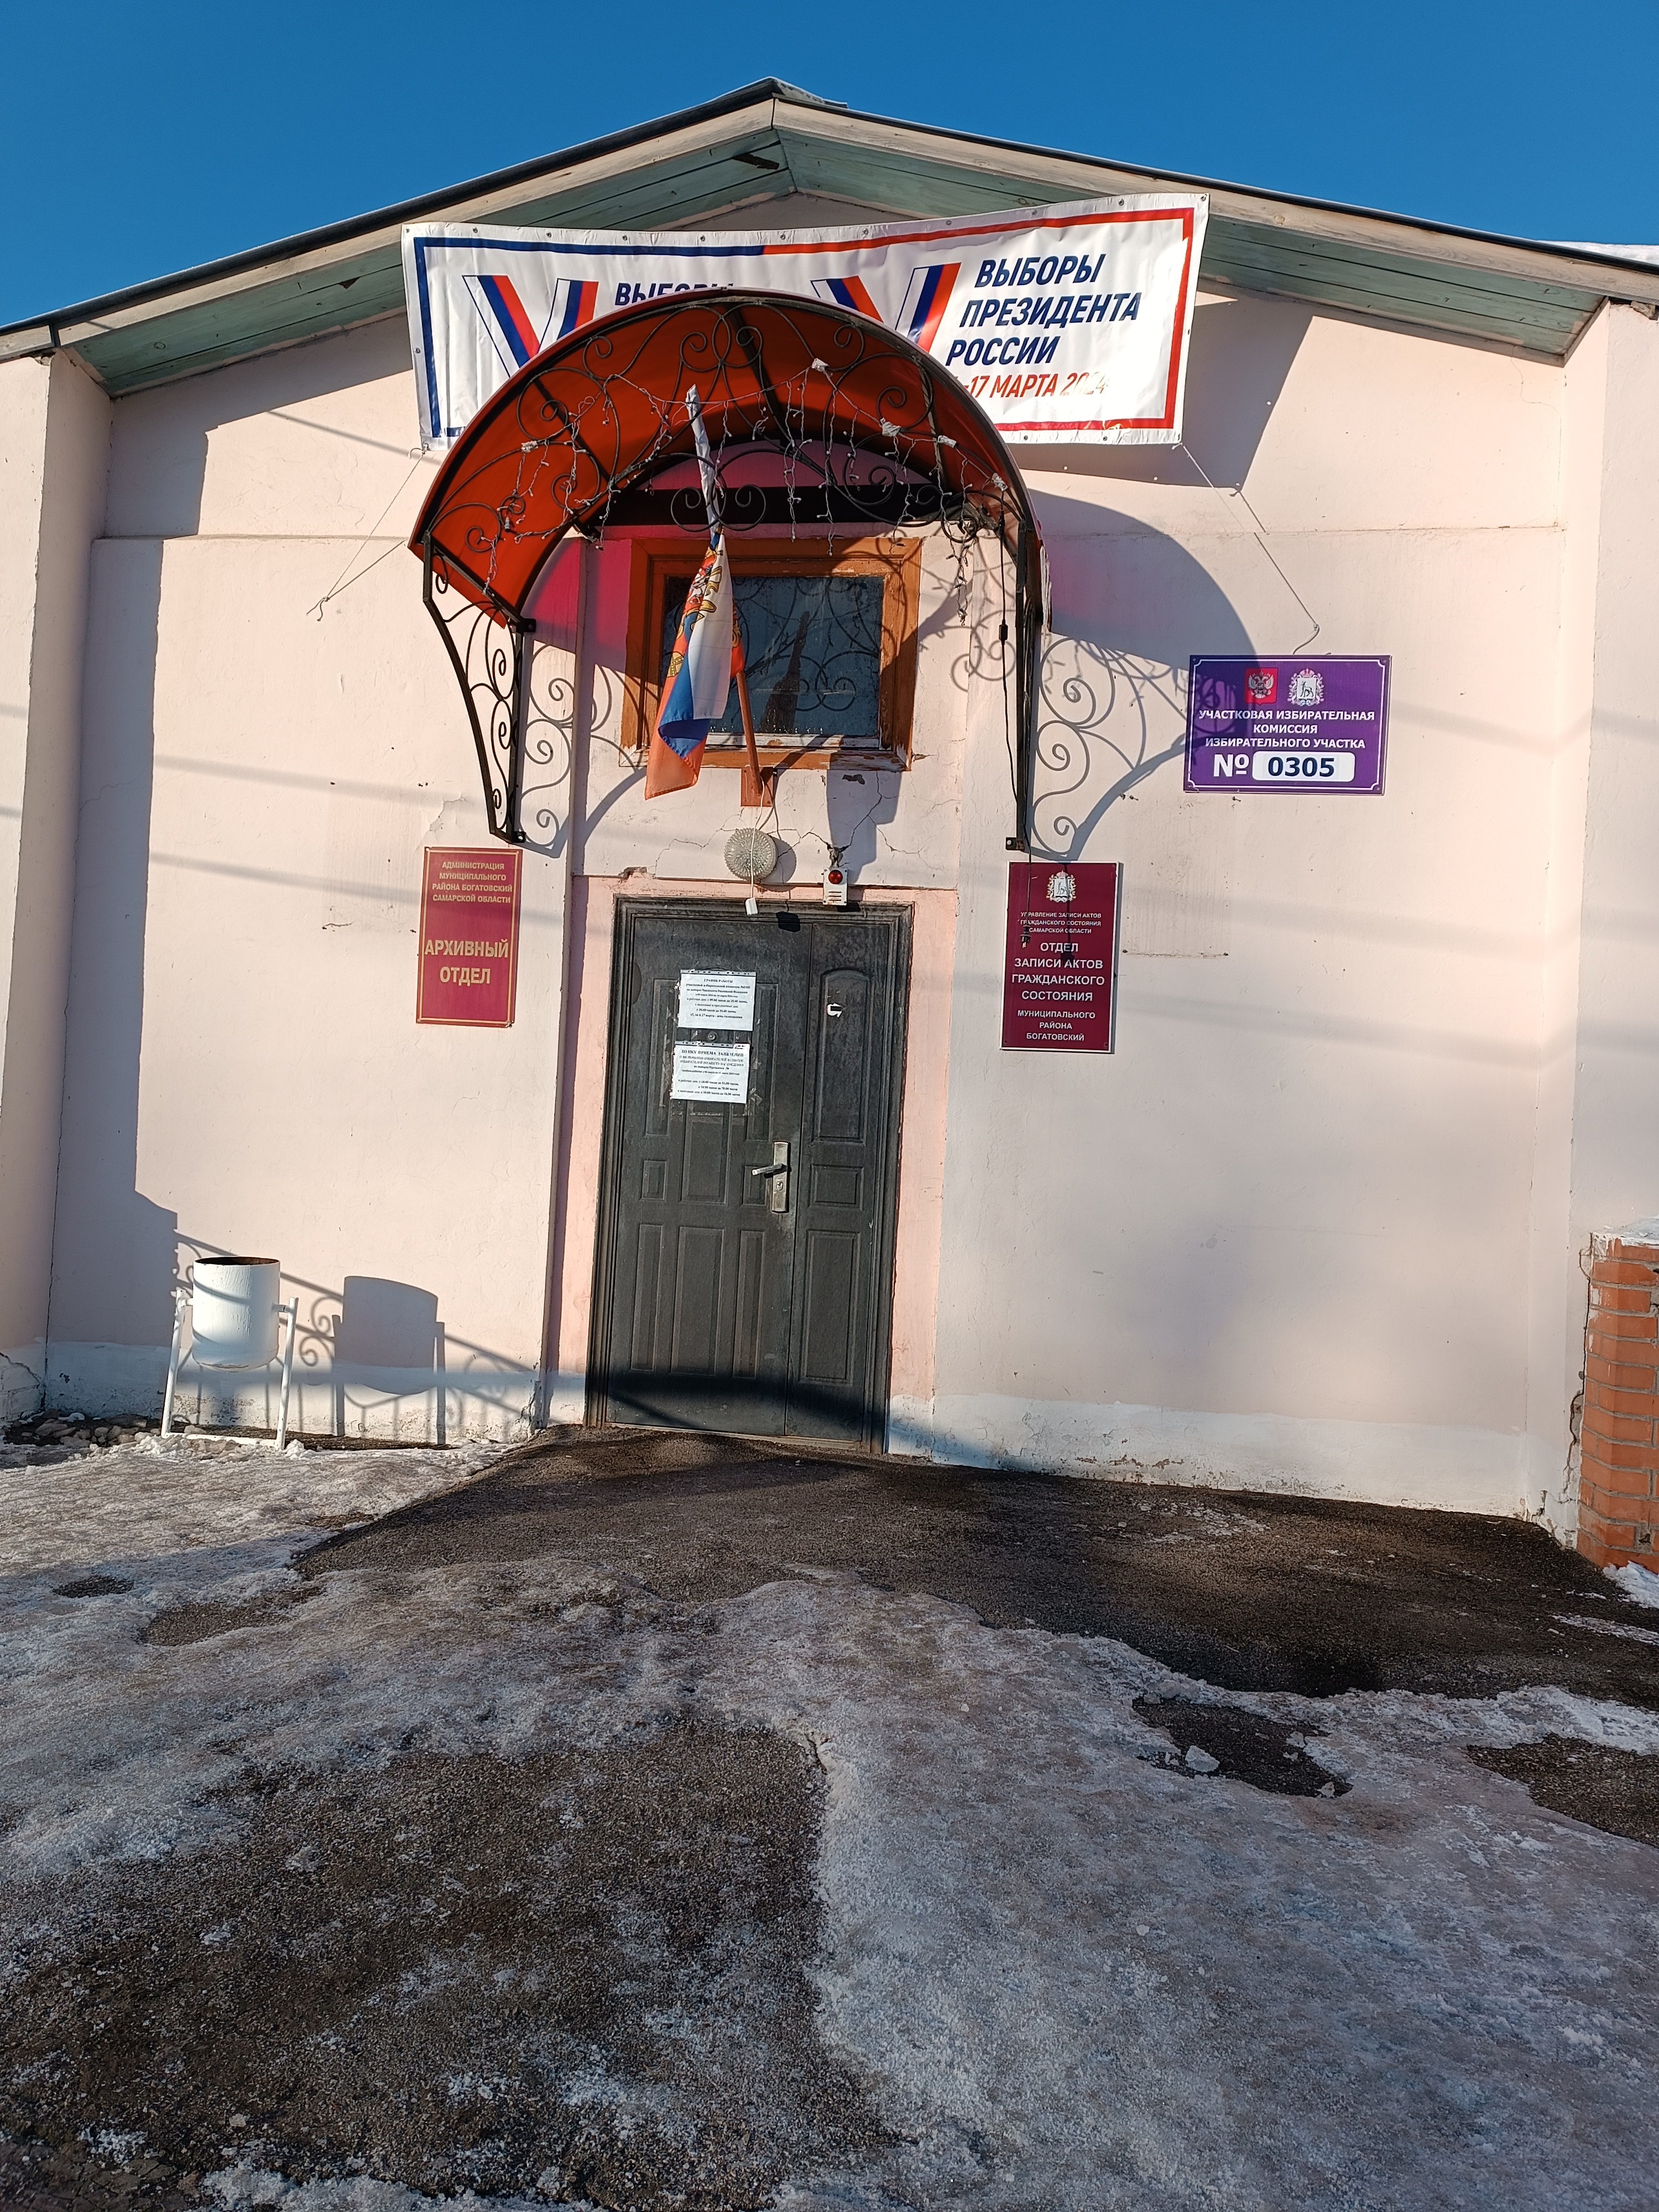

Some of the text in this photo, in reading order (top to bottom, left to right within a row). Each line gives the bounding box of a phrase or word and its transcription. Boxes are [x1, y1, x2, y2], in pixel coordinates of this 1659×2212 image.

[974, 254, 1106, 288] ВЫБОРЫ
[615, 283, 733, 305] ВЫБ
[959, 292, 1142, 328] ПРЕЗИДЕНТА
[945, 336, 1061, 366] РОССИИ
[989, 373, 1058, 398] МАРТА
[1199, 709, 1375, 721] УЧАСТКОВАЯ ИЗБИРАТЕЛЬНАЯ
[1253, 724, 1318, 734] КОМИССИЯ
[1206, 738, 1365, 748] ИЗБИРАТЕЛЬНОГО УЧАСТКА
[1267, 757, 1335, 777] 0305
[442, 862, 504, 870] АДМИНИСТРАЦИЯ
[439, 873, 506, 881] МУНИЦИПАЛЬНОГО
[424, 938, 508, 958] АРХИВНЫЙ
[1040, 942, 1078, 953] ОТДЕЛ
[1014, 958, 1103, 969] ЗАПИСИ АКТОВ
[439, 967, 491, 986] ОТДЕЛ
[1011, 974, 1105, 986] ГРАЖДАНСКОГО
[1021, 990, 1093, 1001] СОСТОЯНИЯ
[1018, 1009, 1095, 1019] МУНИЦИПАЛЬНОГО
[1026, 1031, 1084, 1041] БОГАТОВСКИЙ
